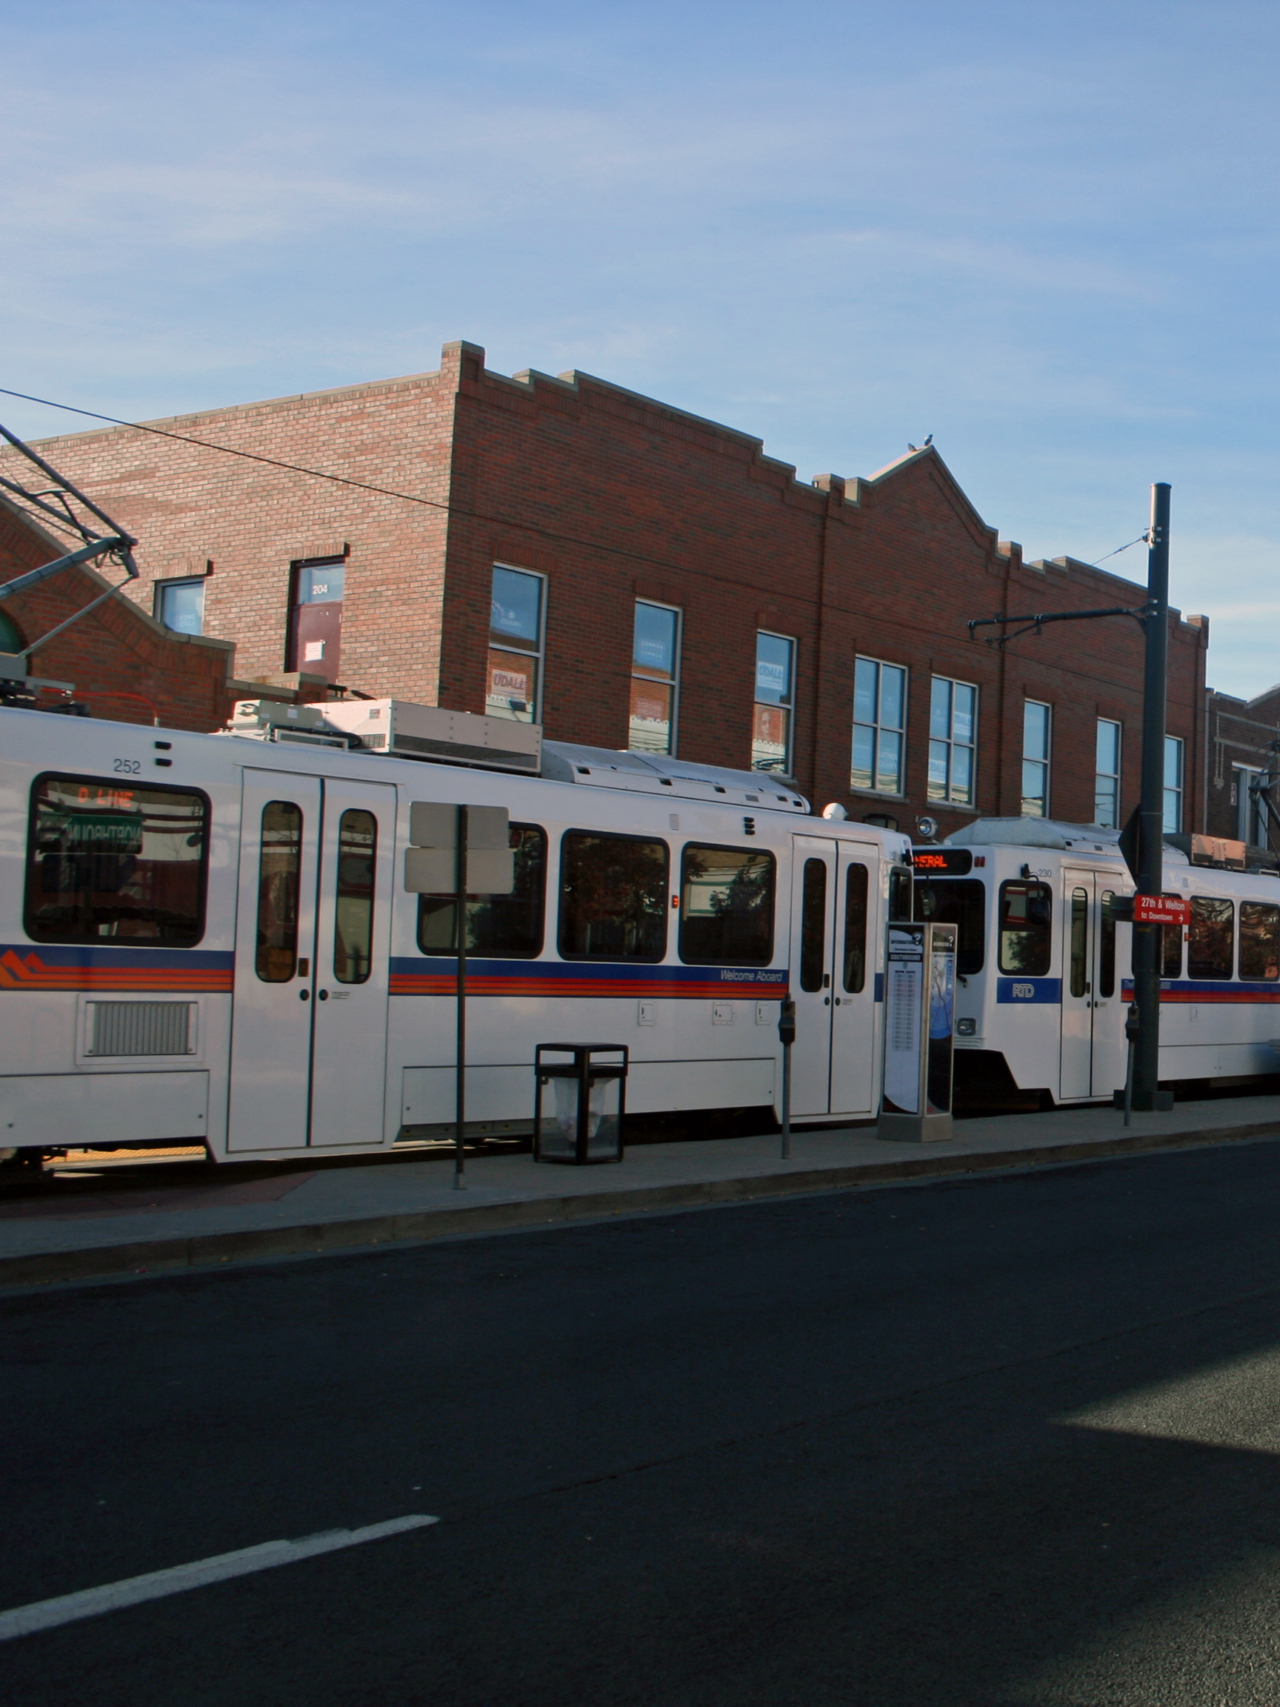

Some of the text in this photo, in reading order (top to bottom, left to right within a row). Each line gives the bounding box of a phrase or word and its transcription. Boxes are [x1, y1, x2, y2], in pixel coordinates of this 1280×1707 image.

[312, 584, 328, 595] 204
[494, 673, 525, 690] UDALL
[113, 758, 141, 775] 252
[77, 786, 135, 808] D LINE
[1038, 868, 1052, 878] 230
[1141, 897, 1185, 911] 27th & Welton
[1149, 911, 1173, 921] Downtown
[720, 969, 783, 982] Welcome Aboard
[1012, 983, 1035, 998] RTD
